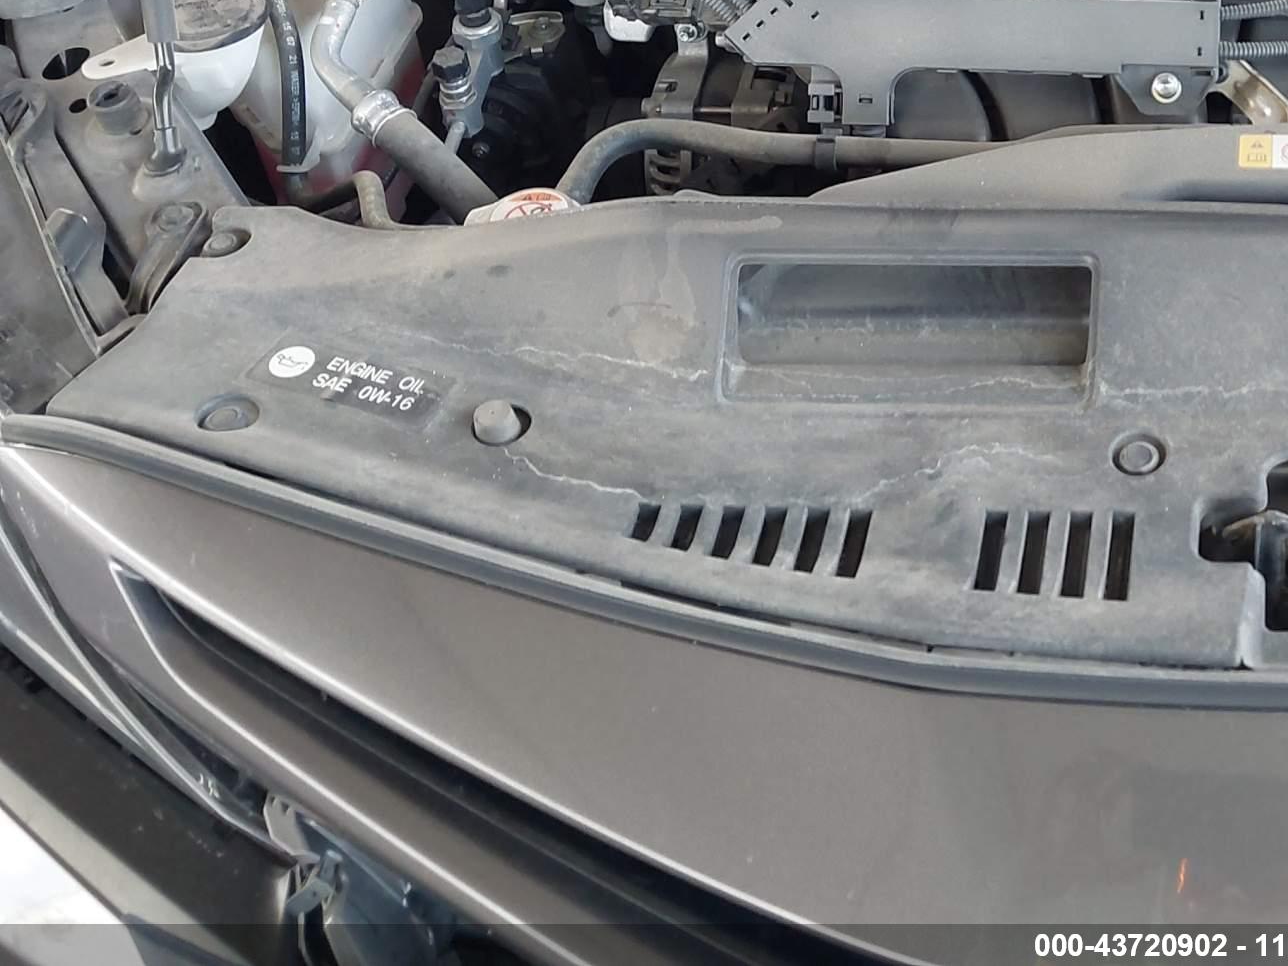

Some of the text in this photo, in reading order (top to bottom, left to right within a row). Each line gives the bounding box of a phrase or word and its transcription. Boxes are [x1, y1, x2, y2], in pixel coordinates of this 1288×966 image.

[312, 372, 415, 411] SAE 0W-16
[326, 356, 425, 394] ENGINE OIL
